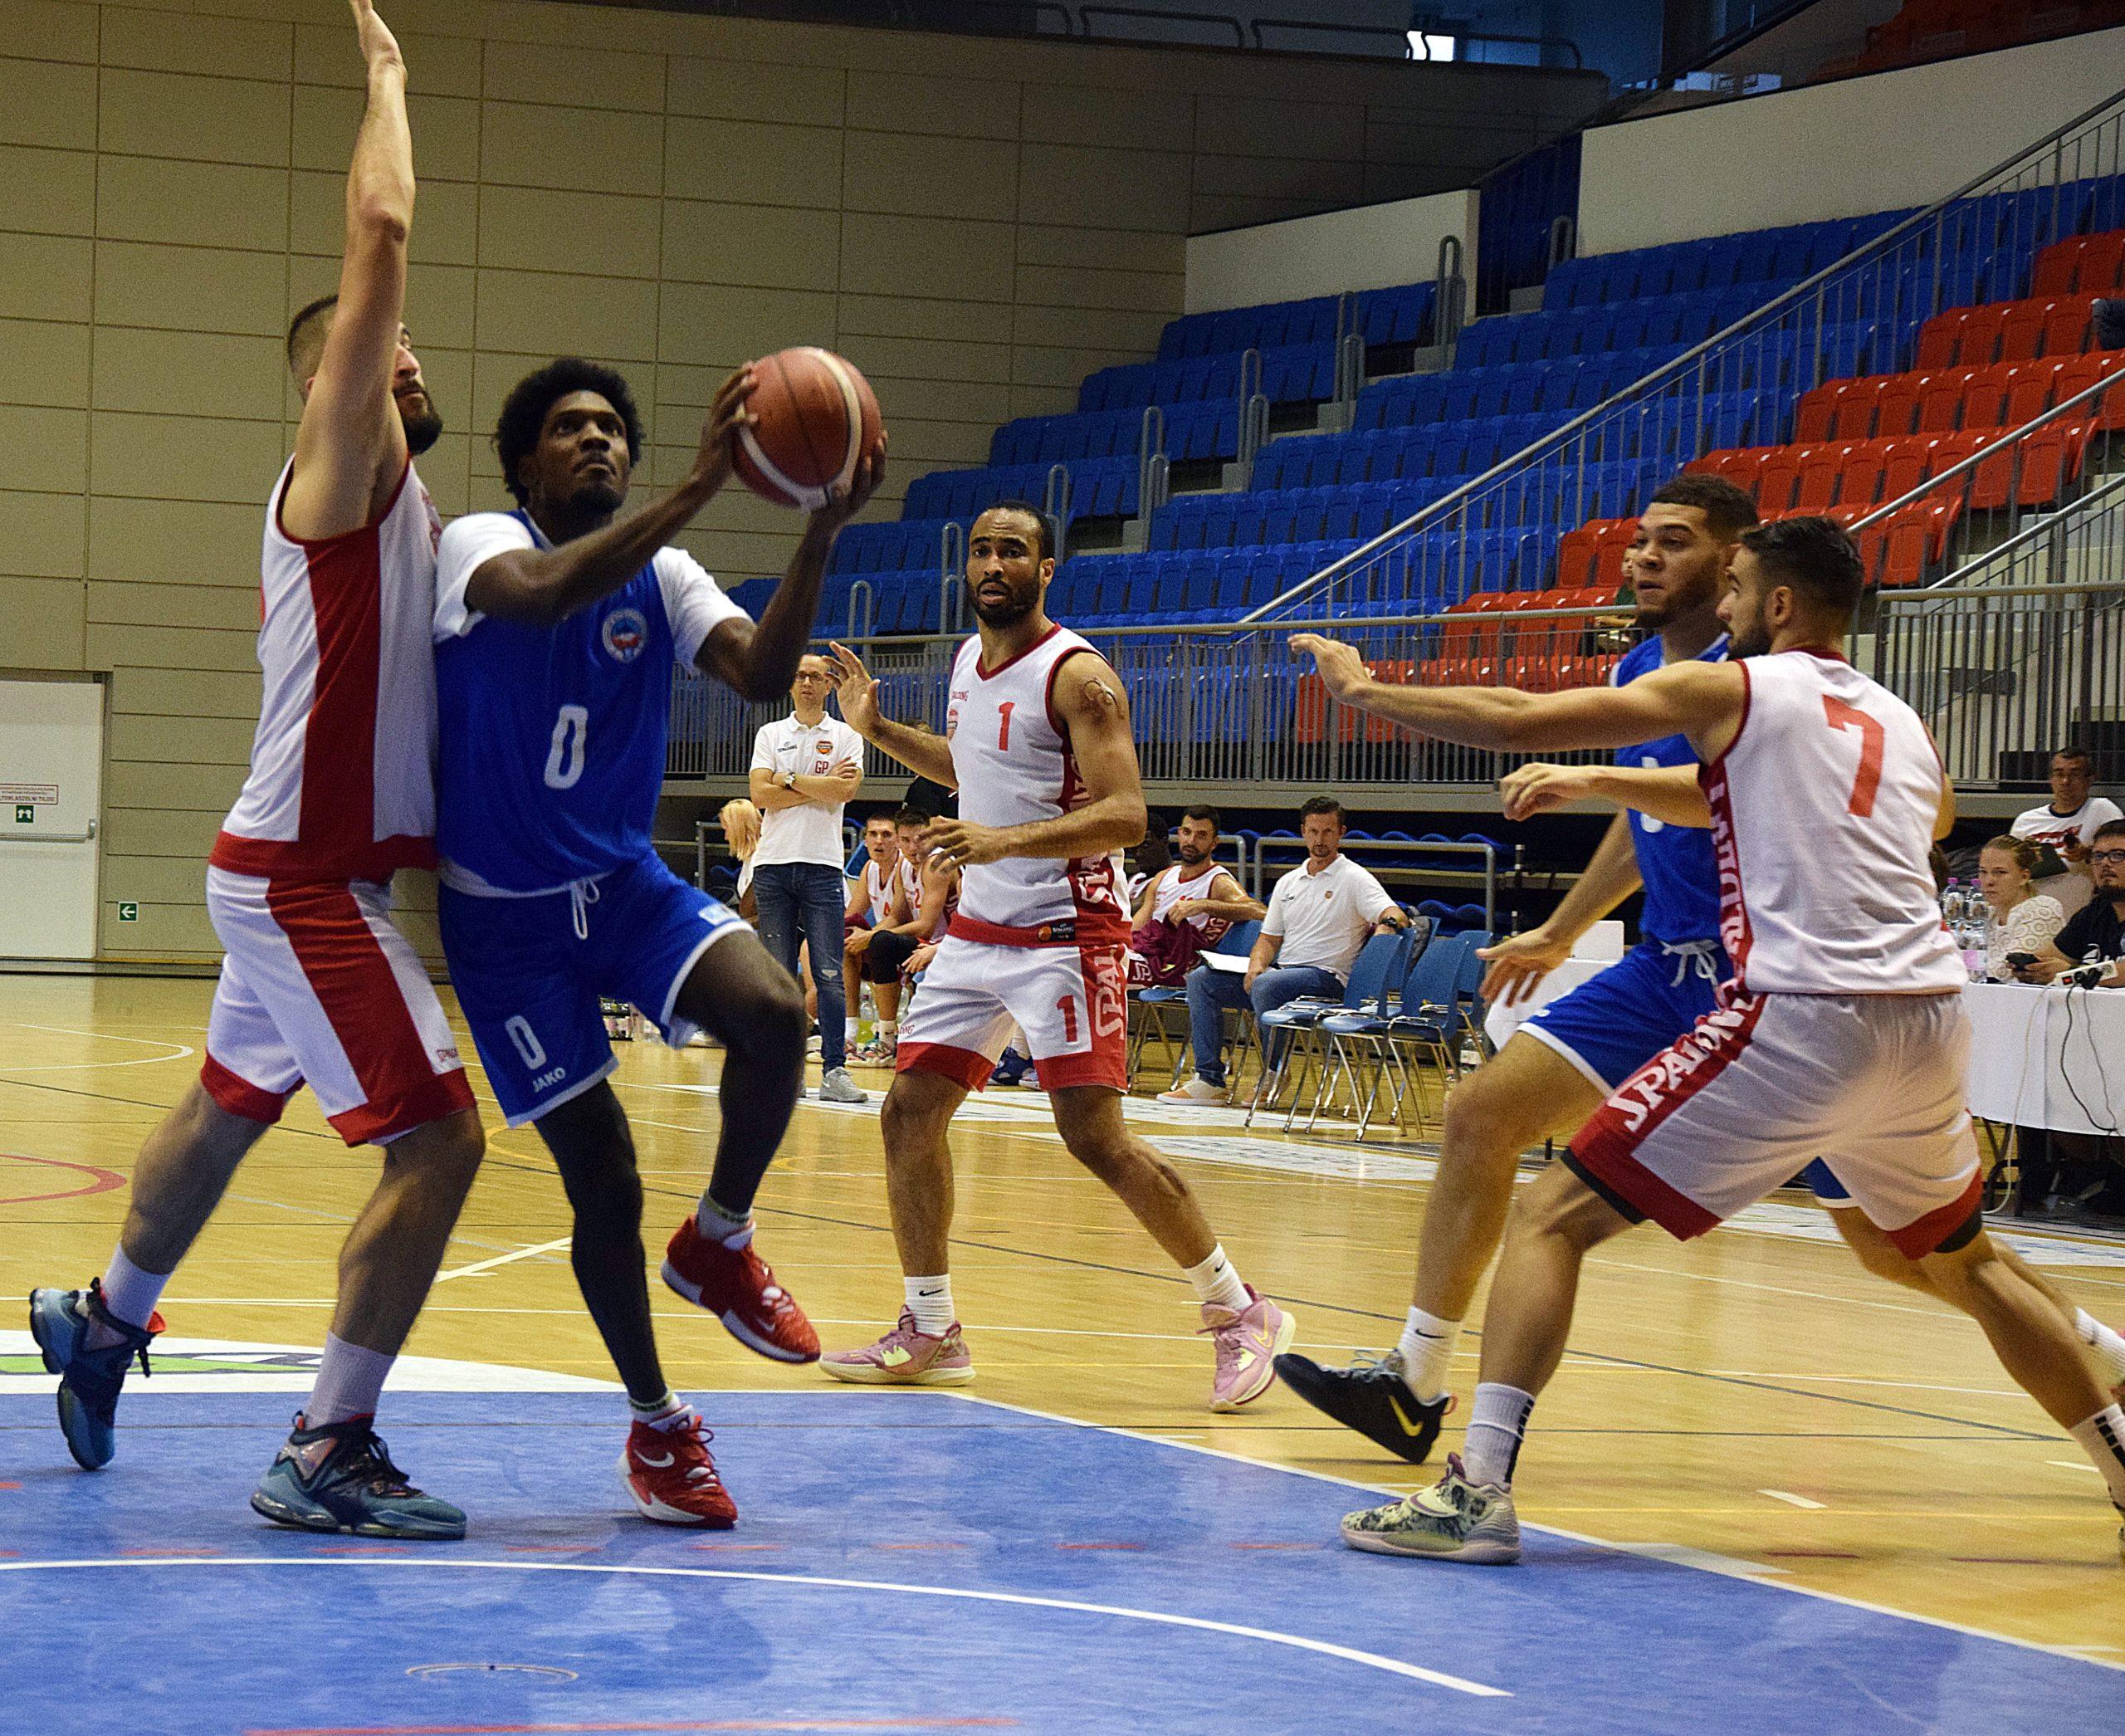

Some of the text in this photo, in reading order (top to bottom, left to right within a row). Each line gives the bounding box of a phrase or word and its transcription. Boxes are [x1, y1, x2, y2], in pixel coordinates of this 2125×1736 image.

[545, 705, 589, 790] 0
[999, 702, 1015, 751] 1
[815, 760, 829, 774] GP
[1822, 694, 1884, 818] 7
[505, 1015, 547, 1070] 0
[1056, 995, 1077, 1042] 1
[532, 1067, 566, 1093] JAKO
